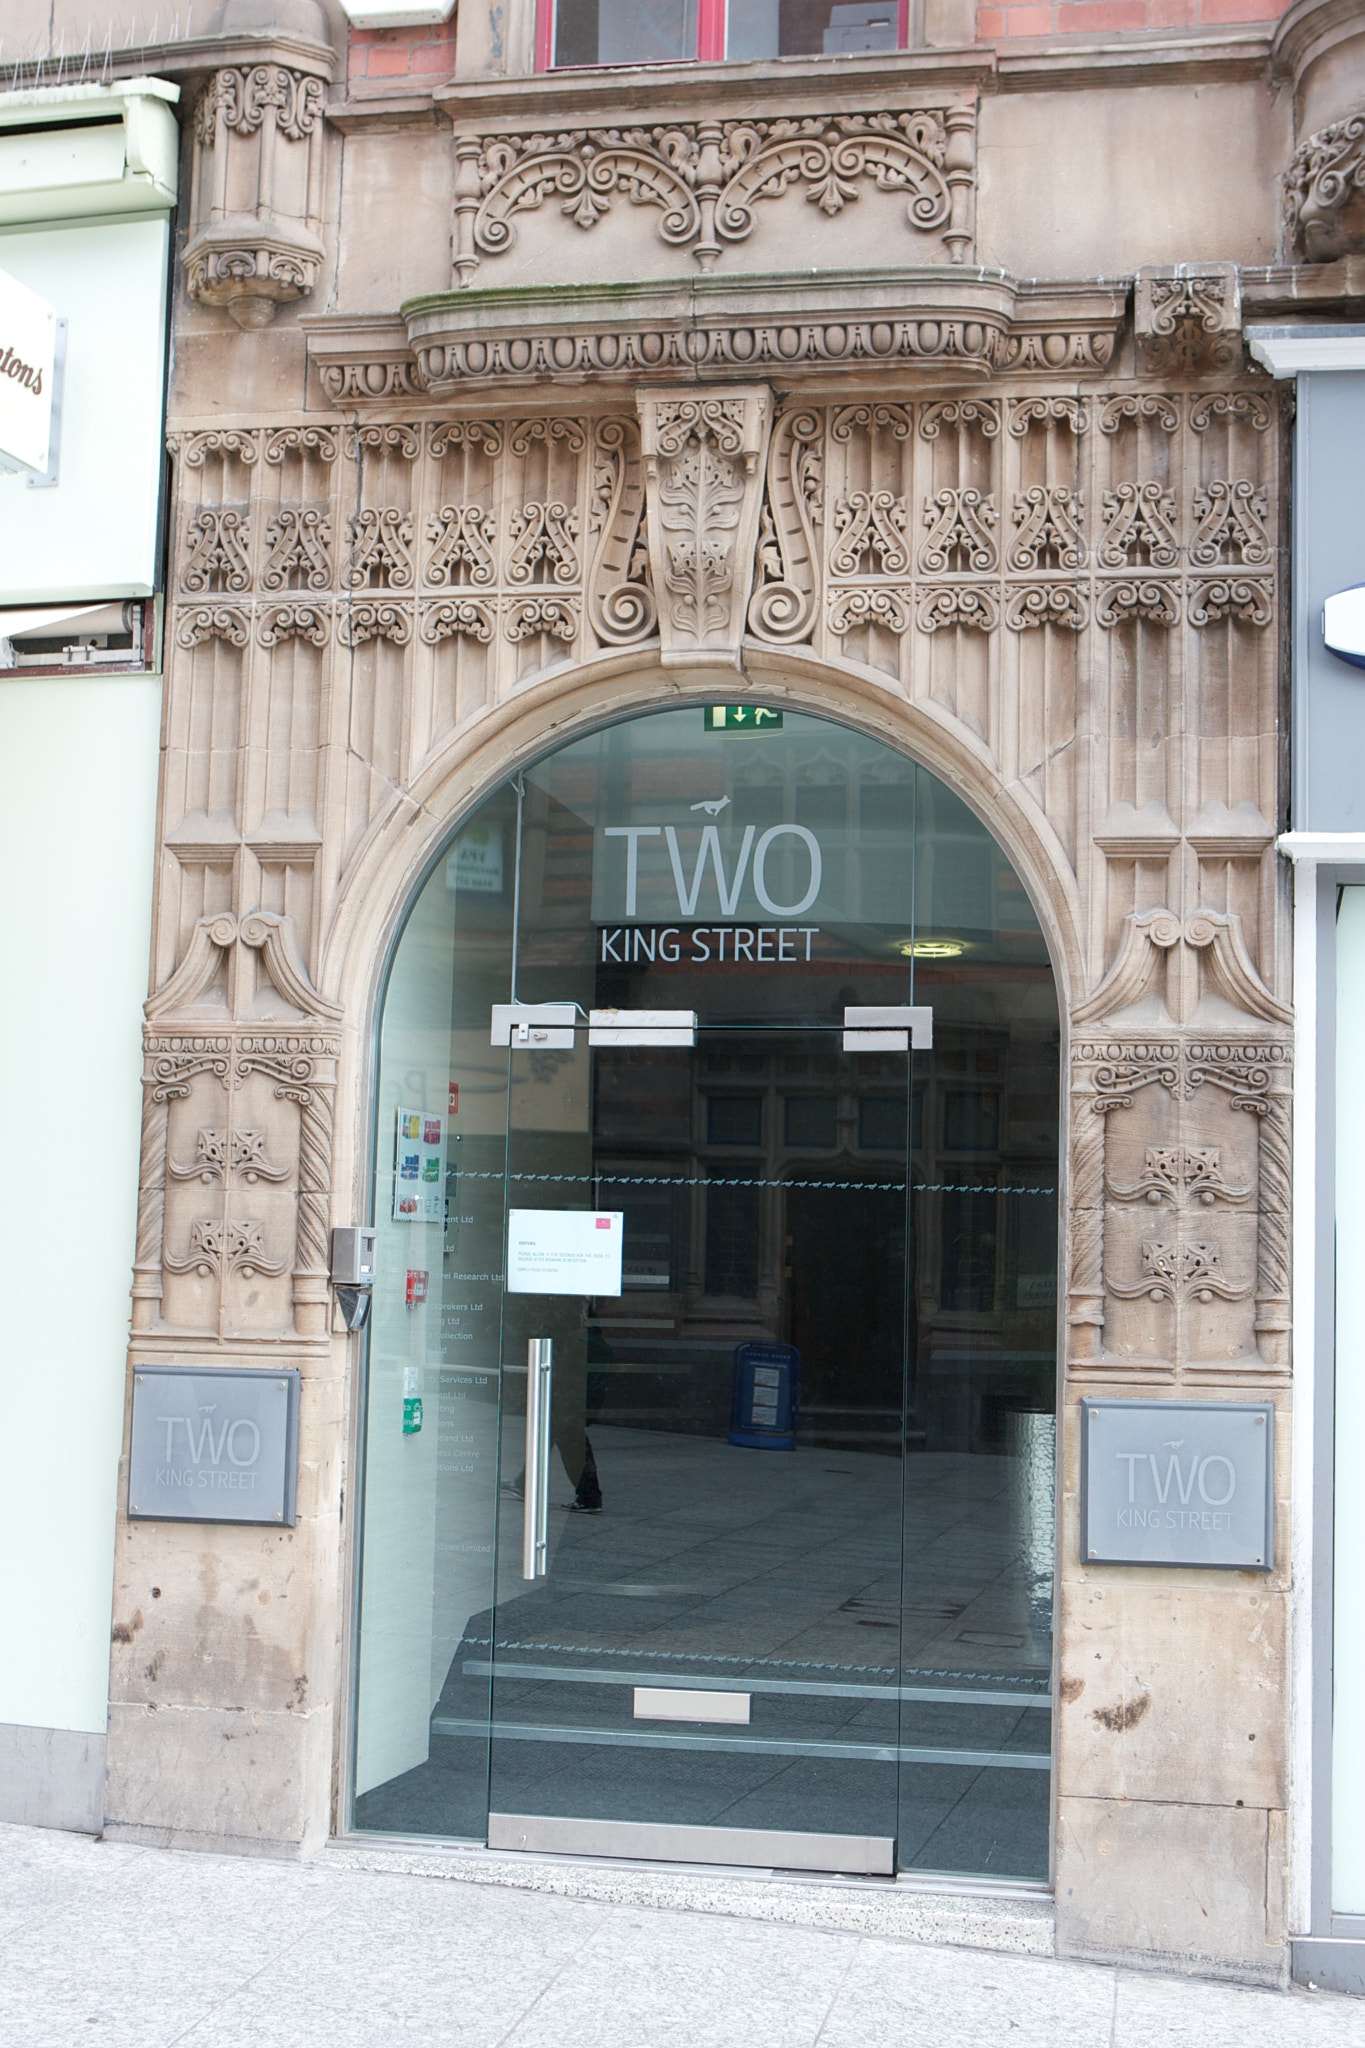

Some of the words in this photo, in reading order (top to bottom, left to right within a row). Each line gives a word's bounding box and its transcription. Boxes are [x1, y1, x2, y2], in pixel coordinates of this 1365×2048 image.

[0, 346, 43, 395] tons
[604, 823, 822, 916] TWO
[601, 928, 680, 963] KING
[691, 928, 820, 962] STREET
[453, 1272, 489, 1280] Research
[470, 1303, 483, 1311] Ltd
[447, 1317, 460, 1325] Ltd
[439, 1375, 473, 1384] Services
[474, 1376, 488, 1384] Ltd
[156, 1416, 261, 1467] TWO
[155, 1468, 194, 1487] KING
[198, 1470, 259, 1490] STREET
[1116, 1453, 1236, 1506] TWO
[1116, 1508, 1160, 1528] KING
[1165, 1510, 1234, 1531] STREET
